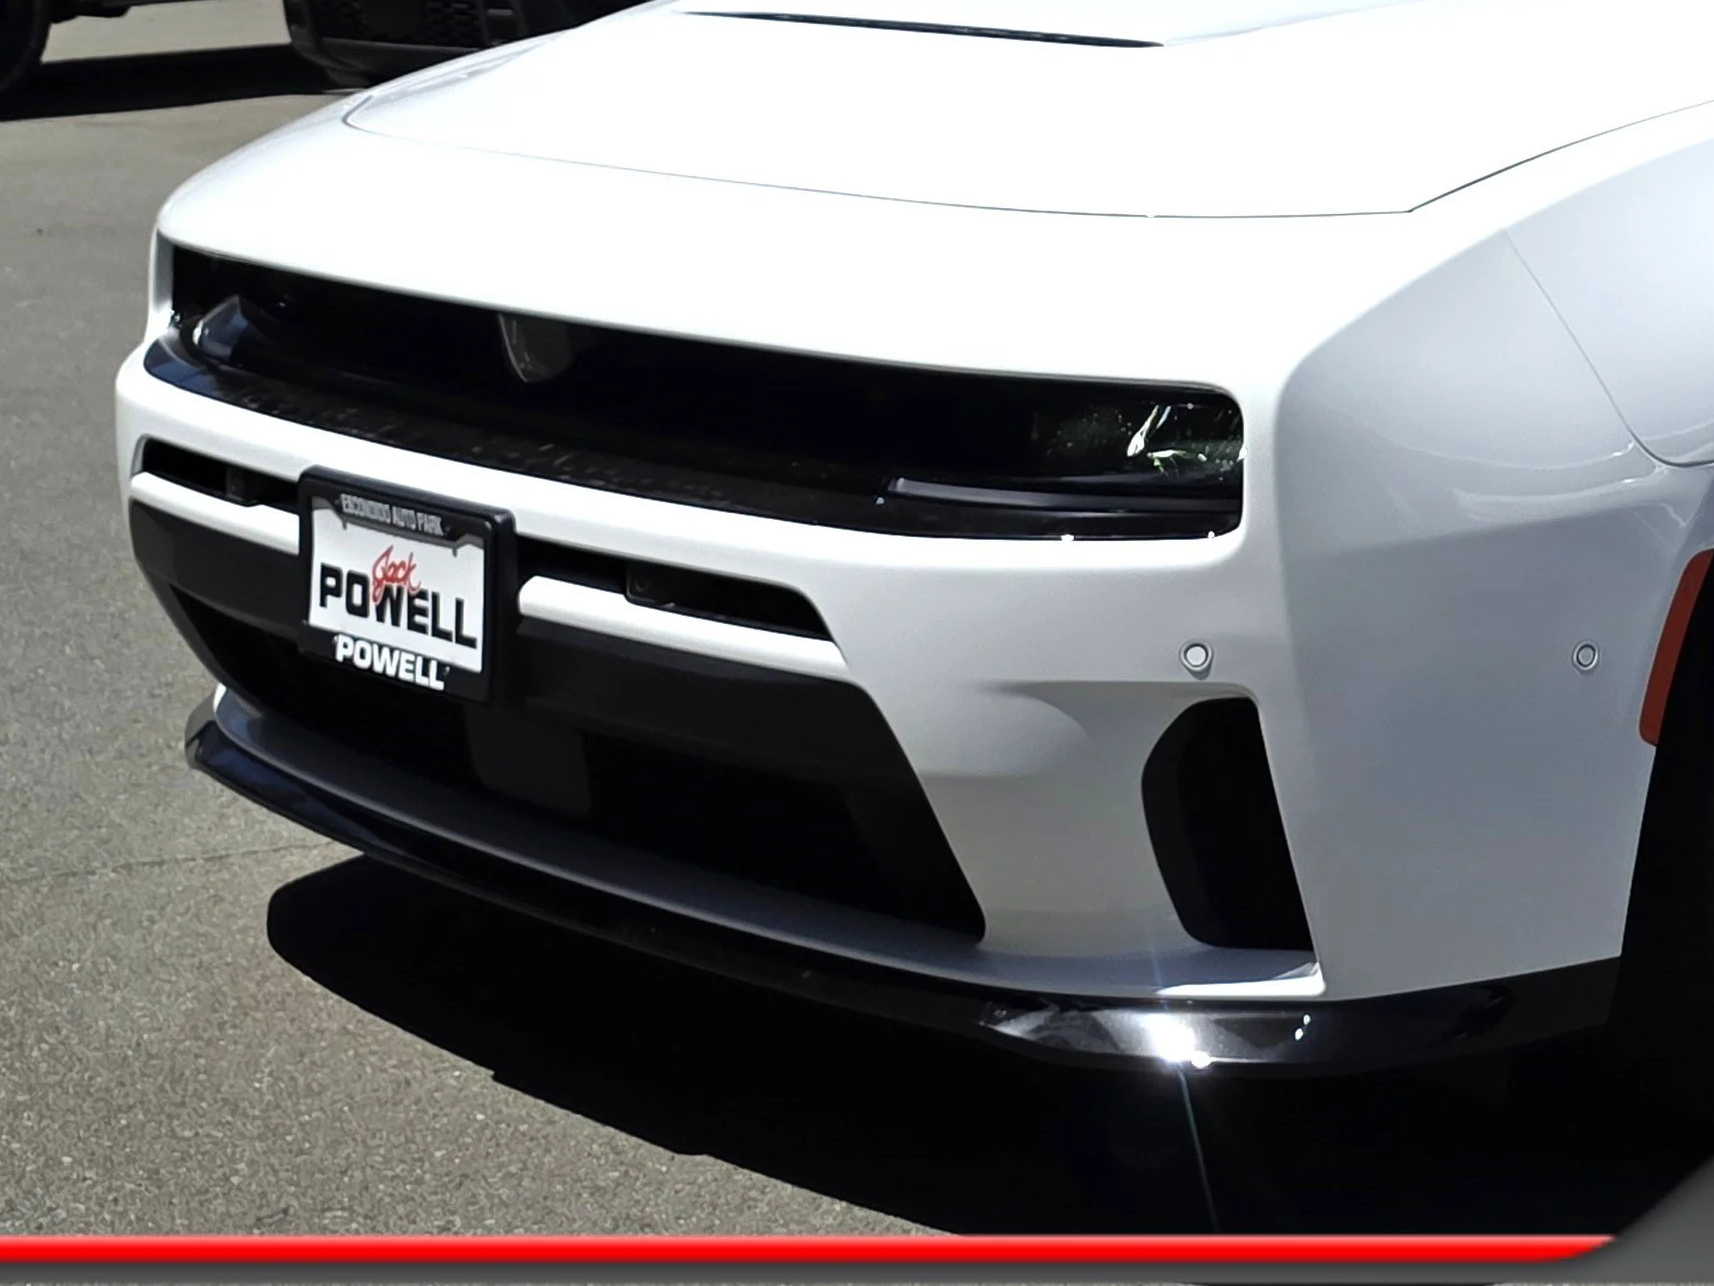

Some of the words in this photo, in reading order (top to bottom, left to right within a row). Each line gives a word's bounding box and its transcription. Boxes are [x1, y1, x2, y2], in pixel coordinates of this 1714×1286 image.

[371, 545, 421, 603] Jack
[318, 562, 478, 650] POWELL
[335, 633, 445, 691] POWELL
